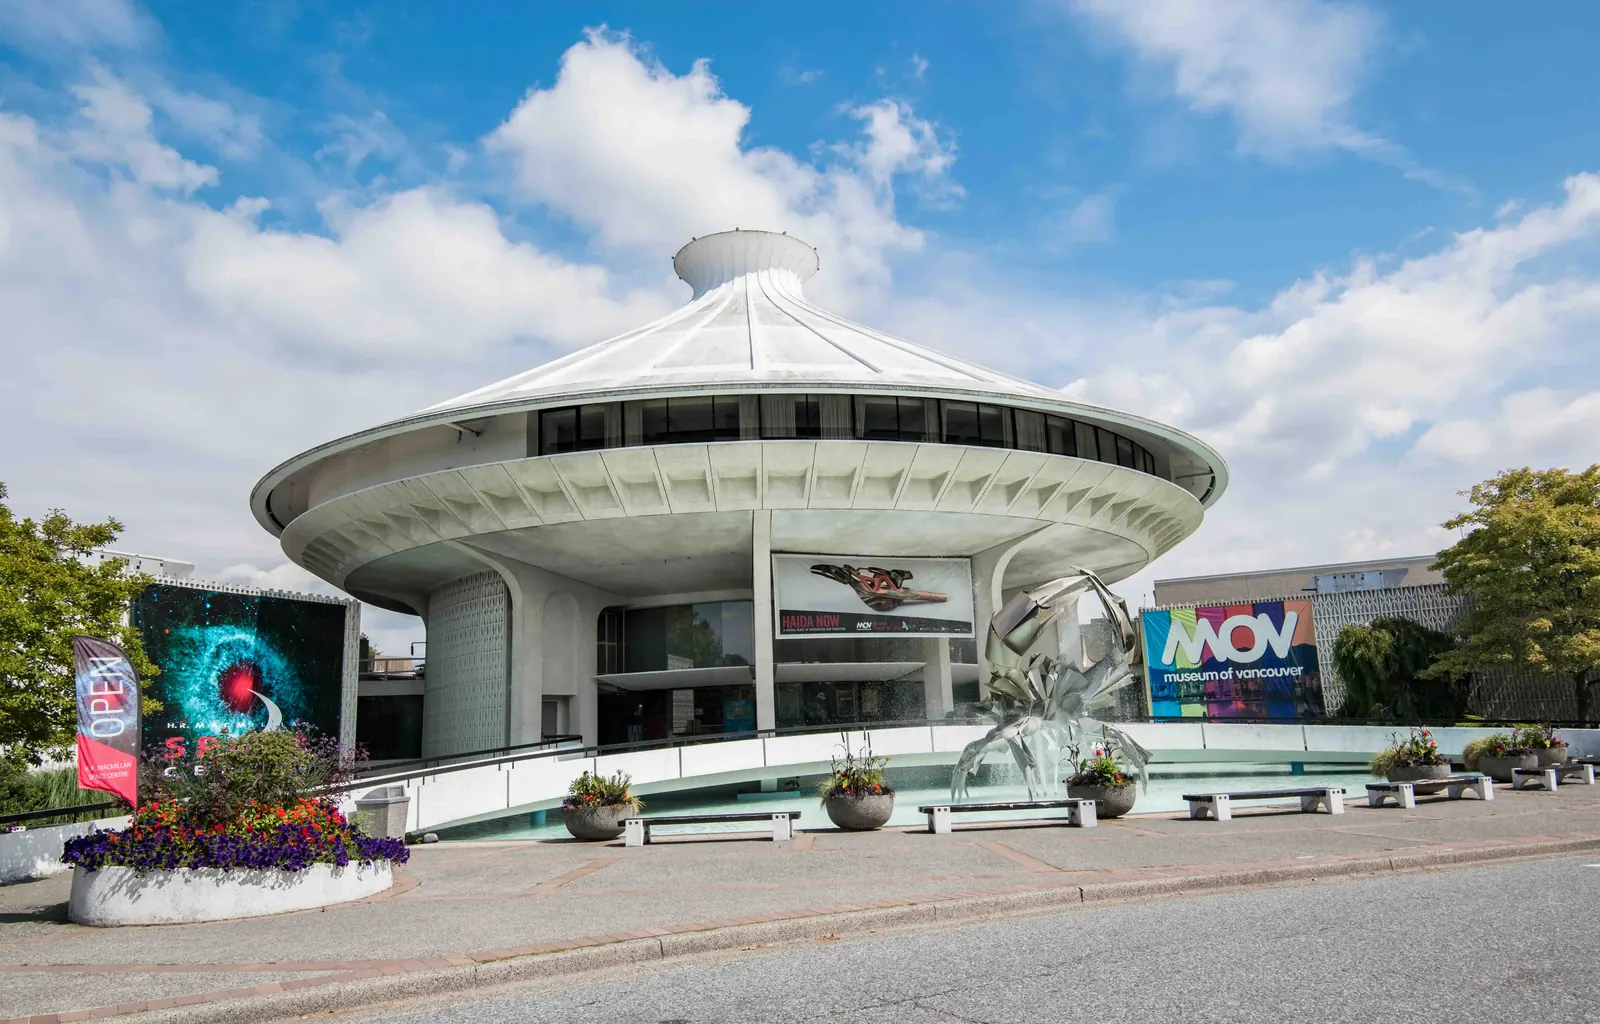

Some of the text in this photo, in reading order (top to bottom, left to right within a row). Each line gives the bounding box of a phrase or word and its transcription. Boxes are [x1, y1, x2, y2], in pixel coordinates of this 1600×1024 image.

[782, 614, 840, 628] HAIDA NOW
[856, 621, 872, 629] MOV
[1161, 611, 1299, 666] MOV
[1164, 665, 1304, 683] museum of vancouver
[89, 656, 125, 738] OPEN
[97, 762, 132, 770] MACMILLAN
